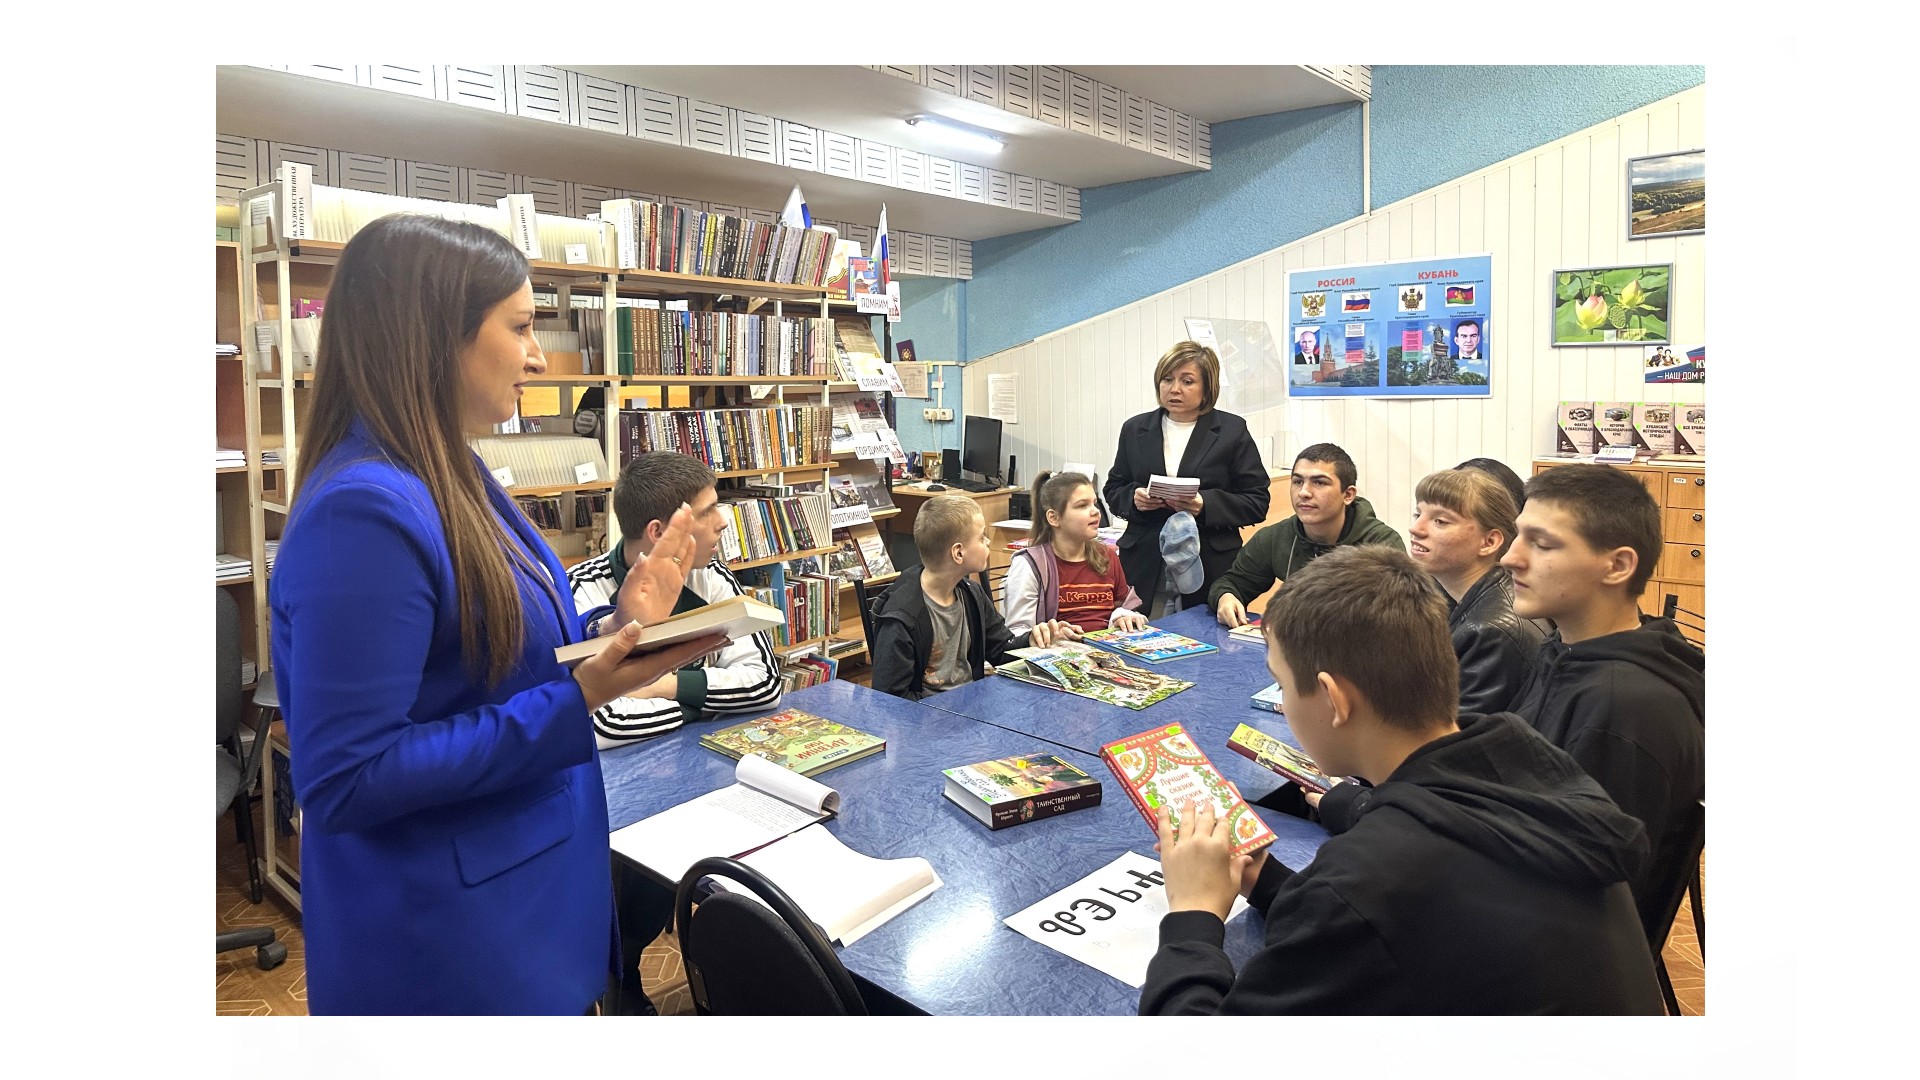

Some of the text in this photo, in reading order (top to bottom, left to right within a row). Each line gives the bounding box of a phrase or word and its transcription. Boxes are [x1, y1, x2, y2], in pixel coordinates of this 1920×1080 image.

[1418, 269, 1459, 280] КУБАНЬ
[1317, 277, 1355, 288] РОССИЯ
[861, 298, 889, 309] ПОМНИМ
[1682, 372, 1698, 380] ДОМ
[862, 378, 889, 387] СЛАВИМ
[687, 416, 695, 443] ЧУЖАК
[692, 416, 700, 443] ЧУЖАК
[855, 445, 891, 456] ГОРДИМСЯ
[1066, 591, 1113, 603] Kappa
[1159, 772, 1190, 787] Лучшие
[1169, 782, 1195, 794] сказки
[1036, 792, 1081, 808] ТАИНСТВЕННЫЙ
[1173, 790, 1203, 806] русских
